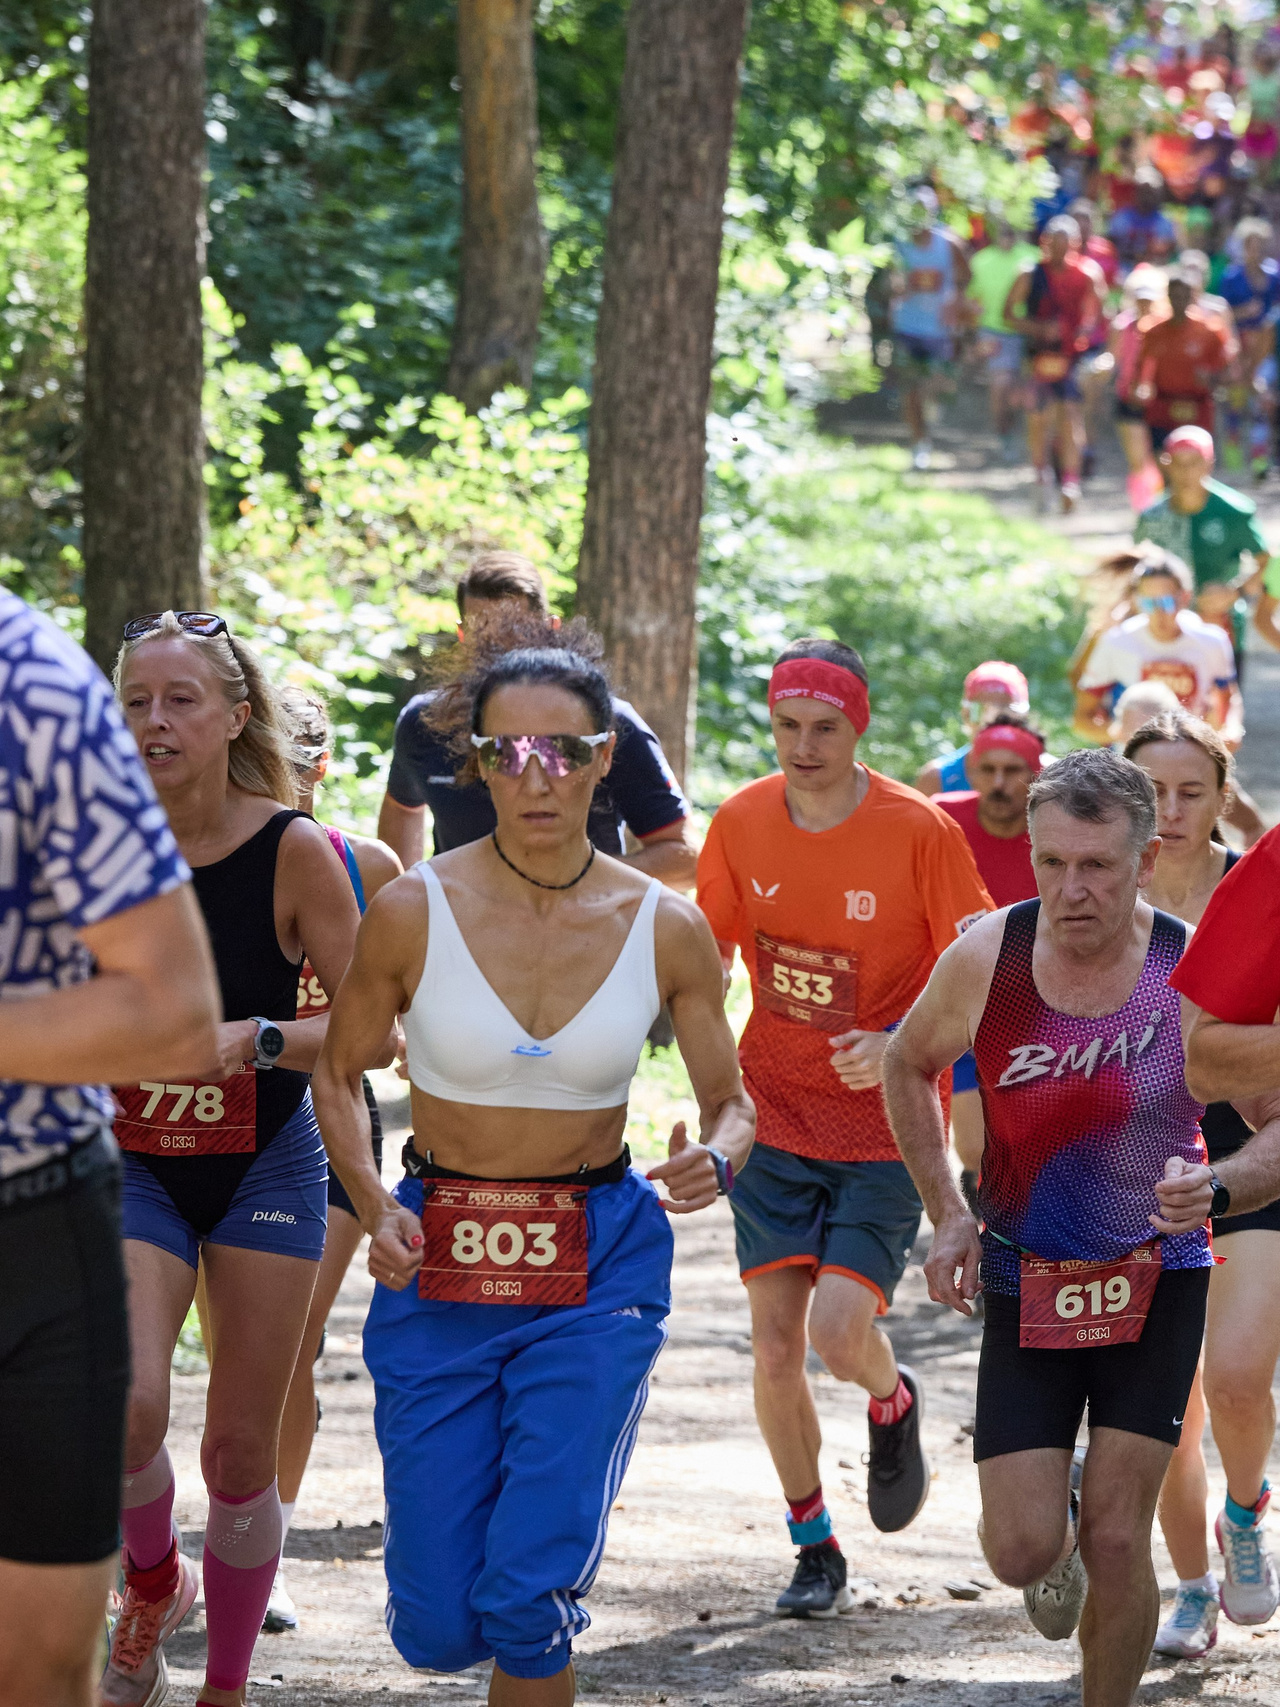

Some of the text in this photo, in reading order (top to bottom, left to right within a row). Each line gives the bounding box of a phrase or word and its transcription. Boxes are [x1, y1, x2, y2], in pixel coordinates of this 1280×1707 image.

[844, 889, 877, 922] 10
[773, 962, 834, 1005] 533
[139, 1081, 225, 1123] 778
[160, 1135, 170, 1148] 6
[252, 1209, 298, 1225] pulse.
[451, 1220, 558, 1267] 803
[482, 1280, 494, 1295] 6
[1055, 1275, 1131, 1319] 619
[1076, 1330, 1087, 1341] 6
